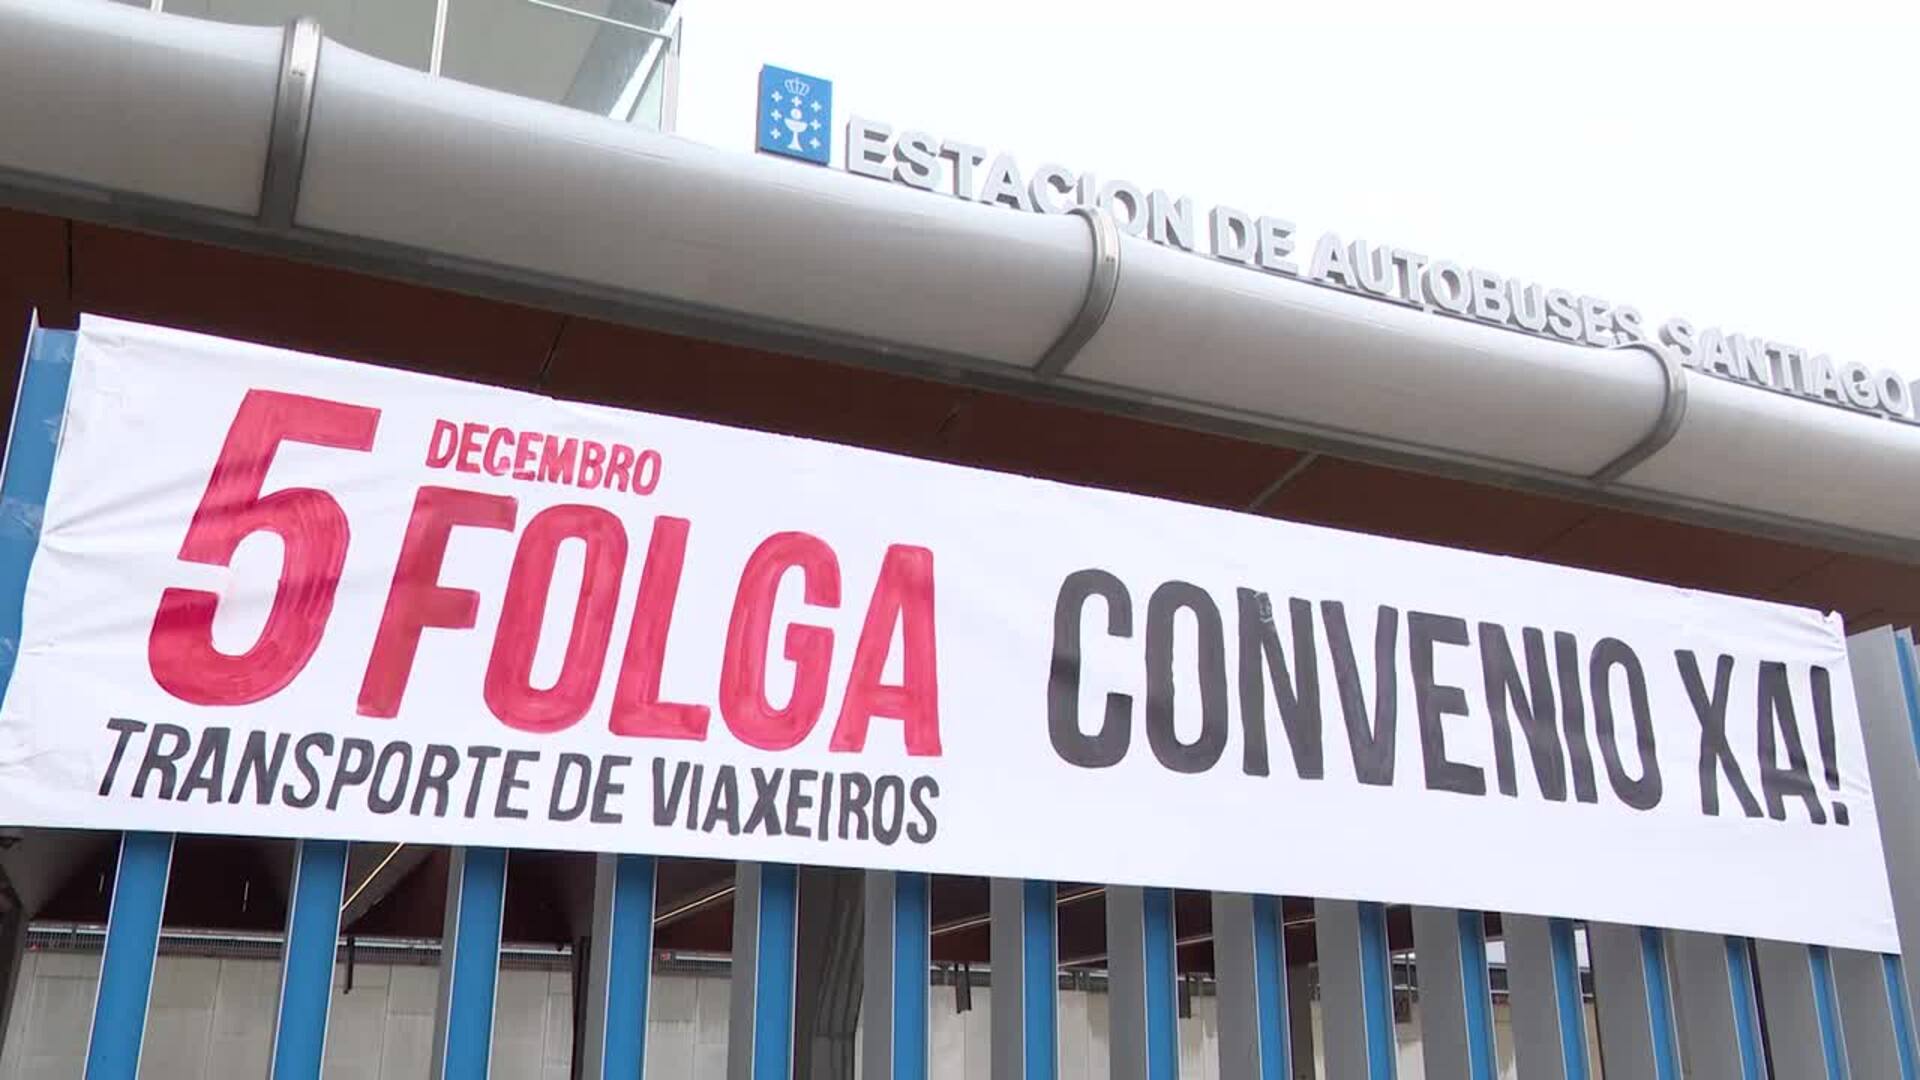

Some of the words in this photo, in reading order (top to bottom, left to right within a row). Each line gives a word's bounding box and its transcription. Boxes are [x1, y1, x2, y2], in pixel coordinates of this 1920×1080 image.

[846, 116, 1194, 251] ESTACION
[1210, 205, 1298, 274] DE
[1310, 232, 1642, 346] AUTOBUSES
[1659, 318, 1909, 414] SANTIAGO
[148, 388, 381, 706] 5
[425, 419, 662, 496] DECEMBRO
[356, 486, 943, 757] FOLGA
[1047, 568, 1662, 811] CONVENIO
[1675, 649, 1850, 826] XA!
[97, 717, 540, 819] TRANSPORTE
[547, 752, 632, 824] DE
[652, 759, 940, 845] VIAXEIROS
